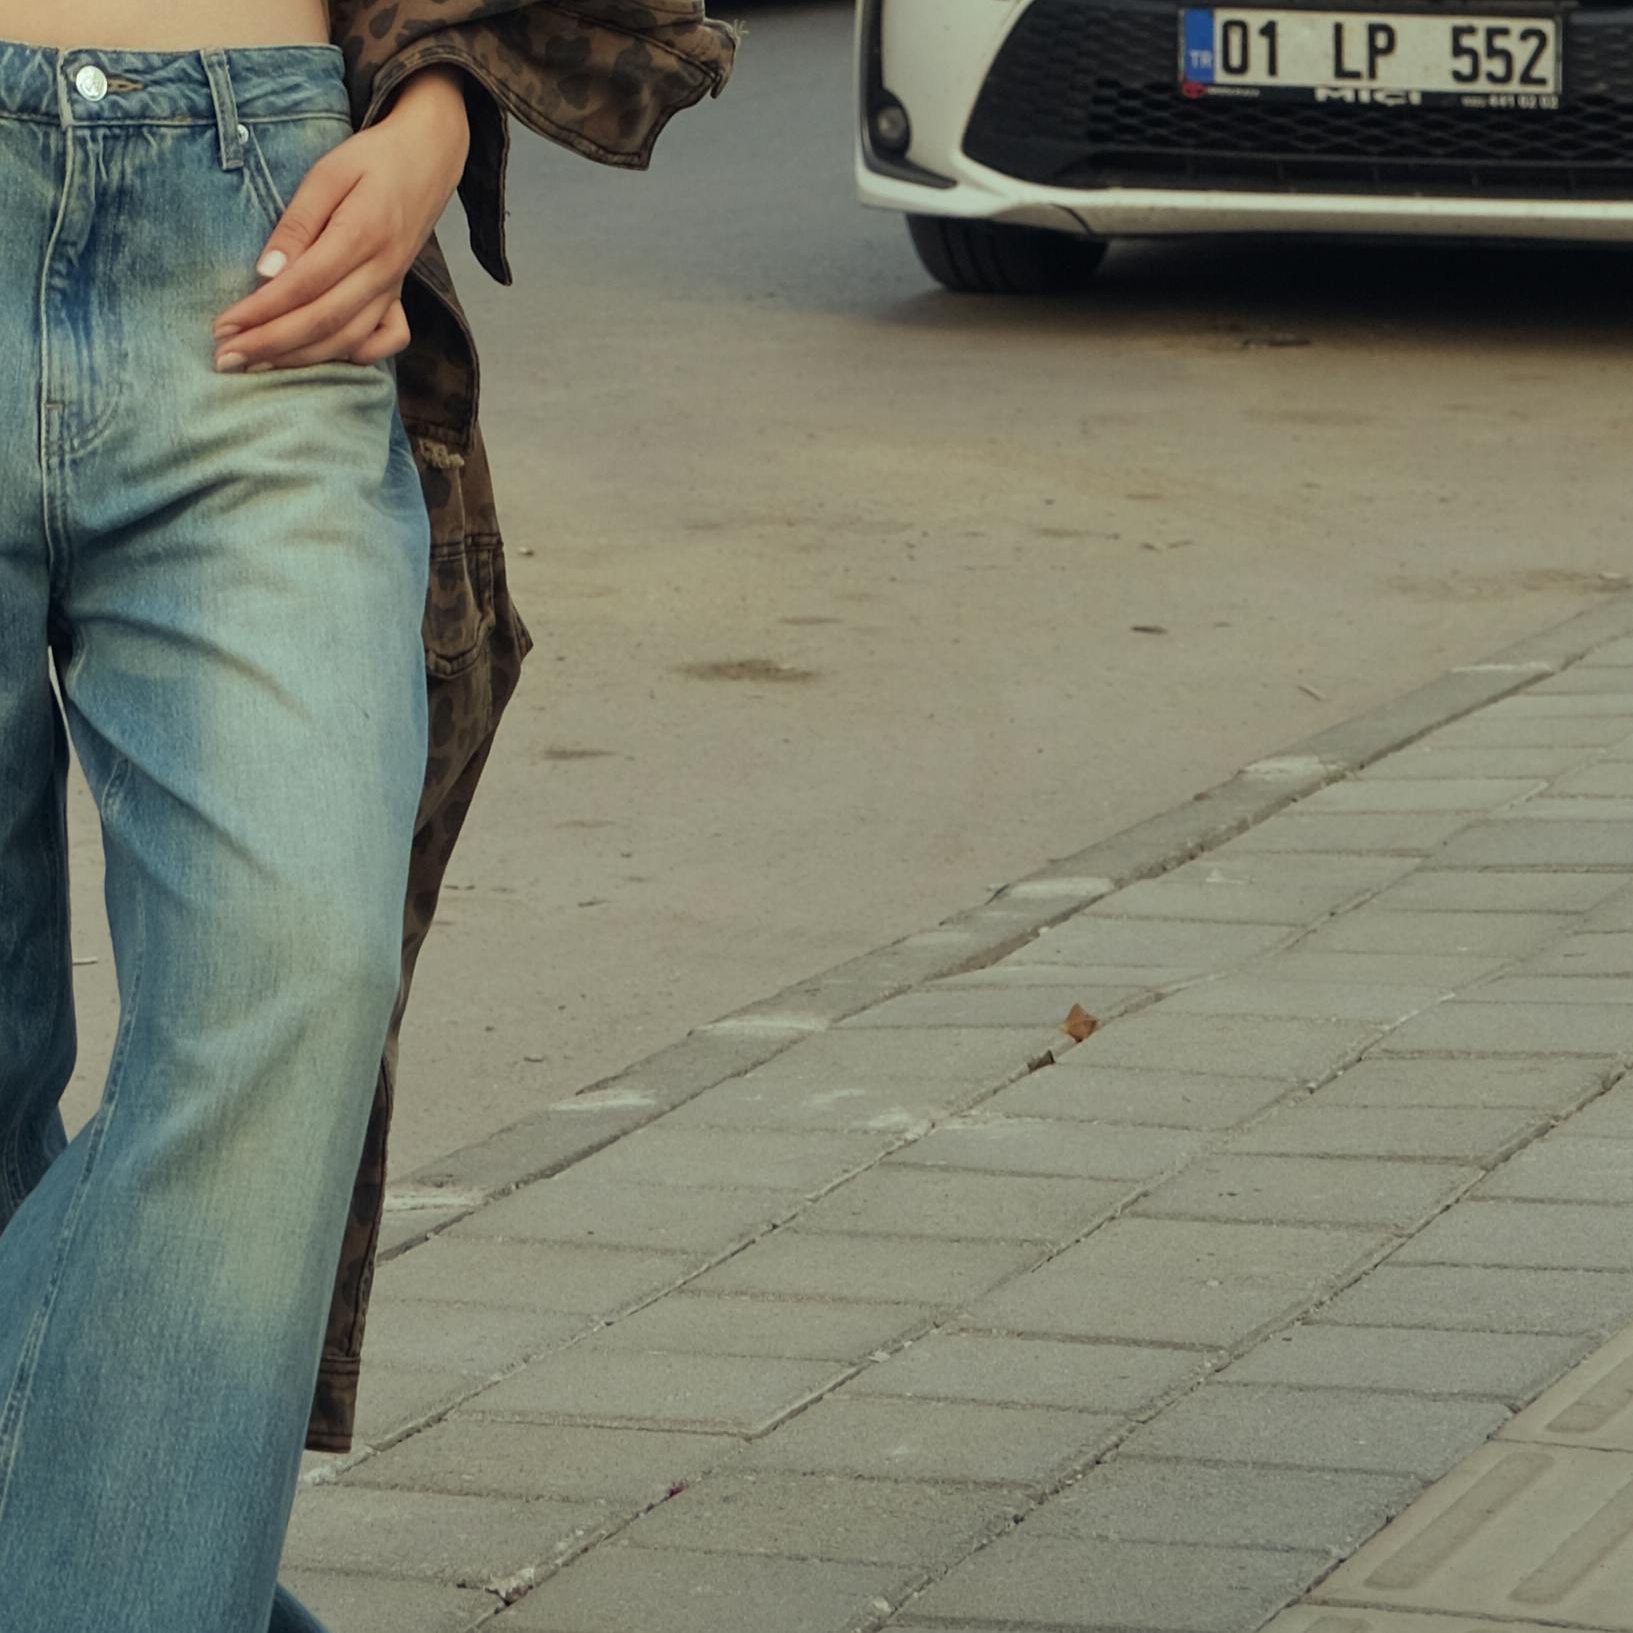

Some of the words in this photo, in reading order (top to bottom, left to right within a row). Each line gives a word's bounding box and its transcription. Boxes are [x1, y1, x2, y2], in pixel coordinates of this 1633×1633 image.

[1190, 50, 1212, 68] TR
[1221, 19, 1278, 77] 01
[1333, 22, 1397, 80] LP
[1450, 25, 1548, 86] 552
